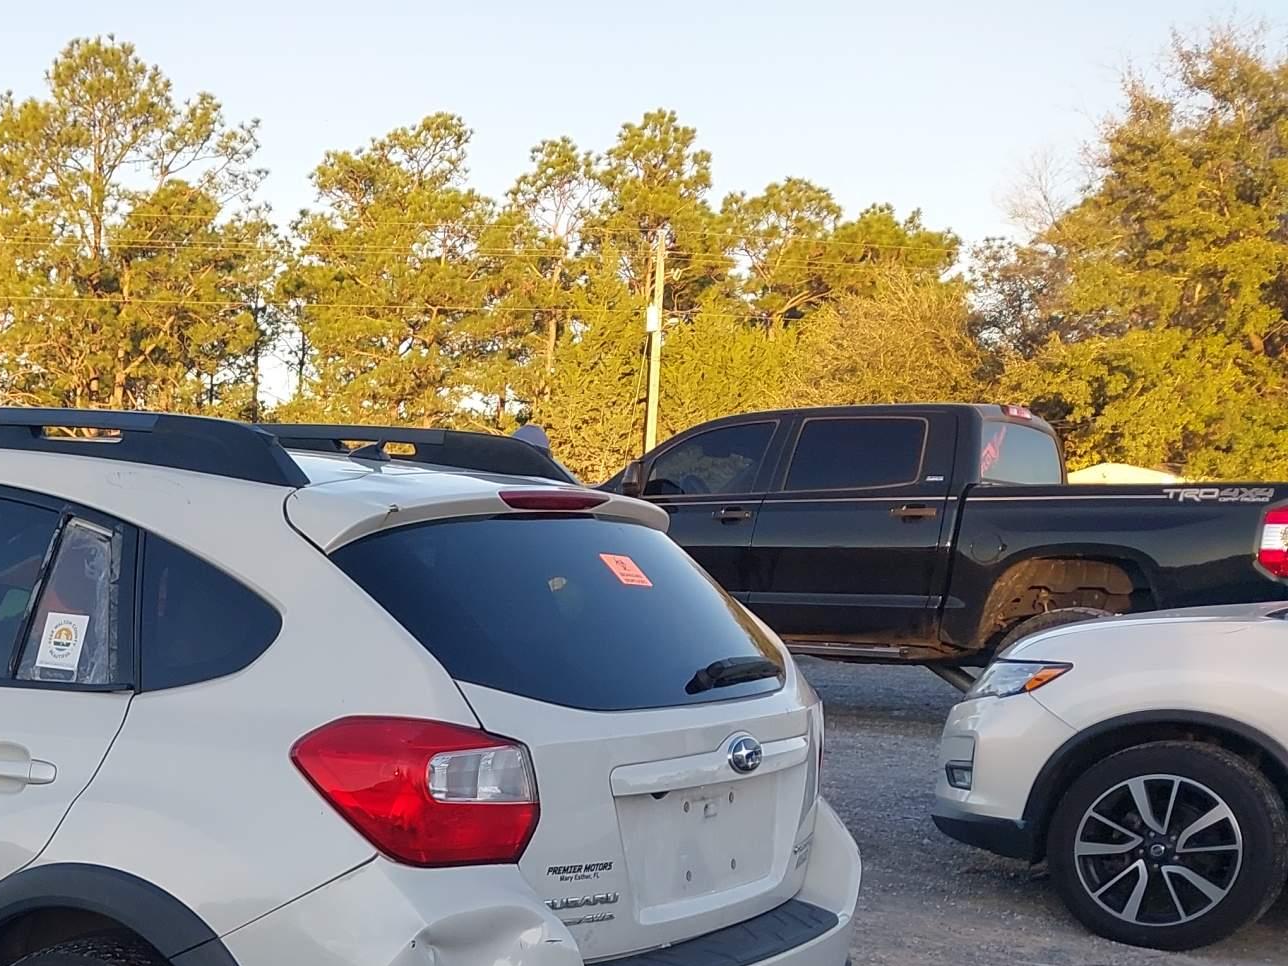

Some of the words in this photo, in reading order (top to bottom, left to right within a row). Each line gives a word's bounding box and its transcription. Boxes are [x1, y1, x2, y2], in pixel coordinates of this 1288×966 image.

[1162, 488, 1219, 502] TRD
[546, 864, 584, 875] PREMIER
[583, 861, 614, 872] MOTORS
